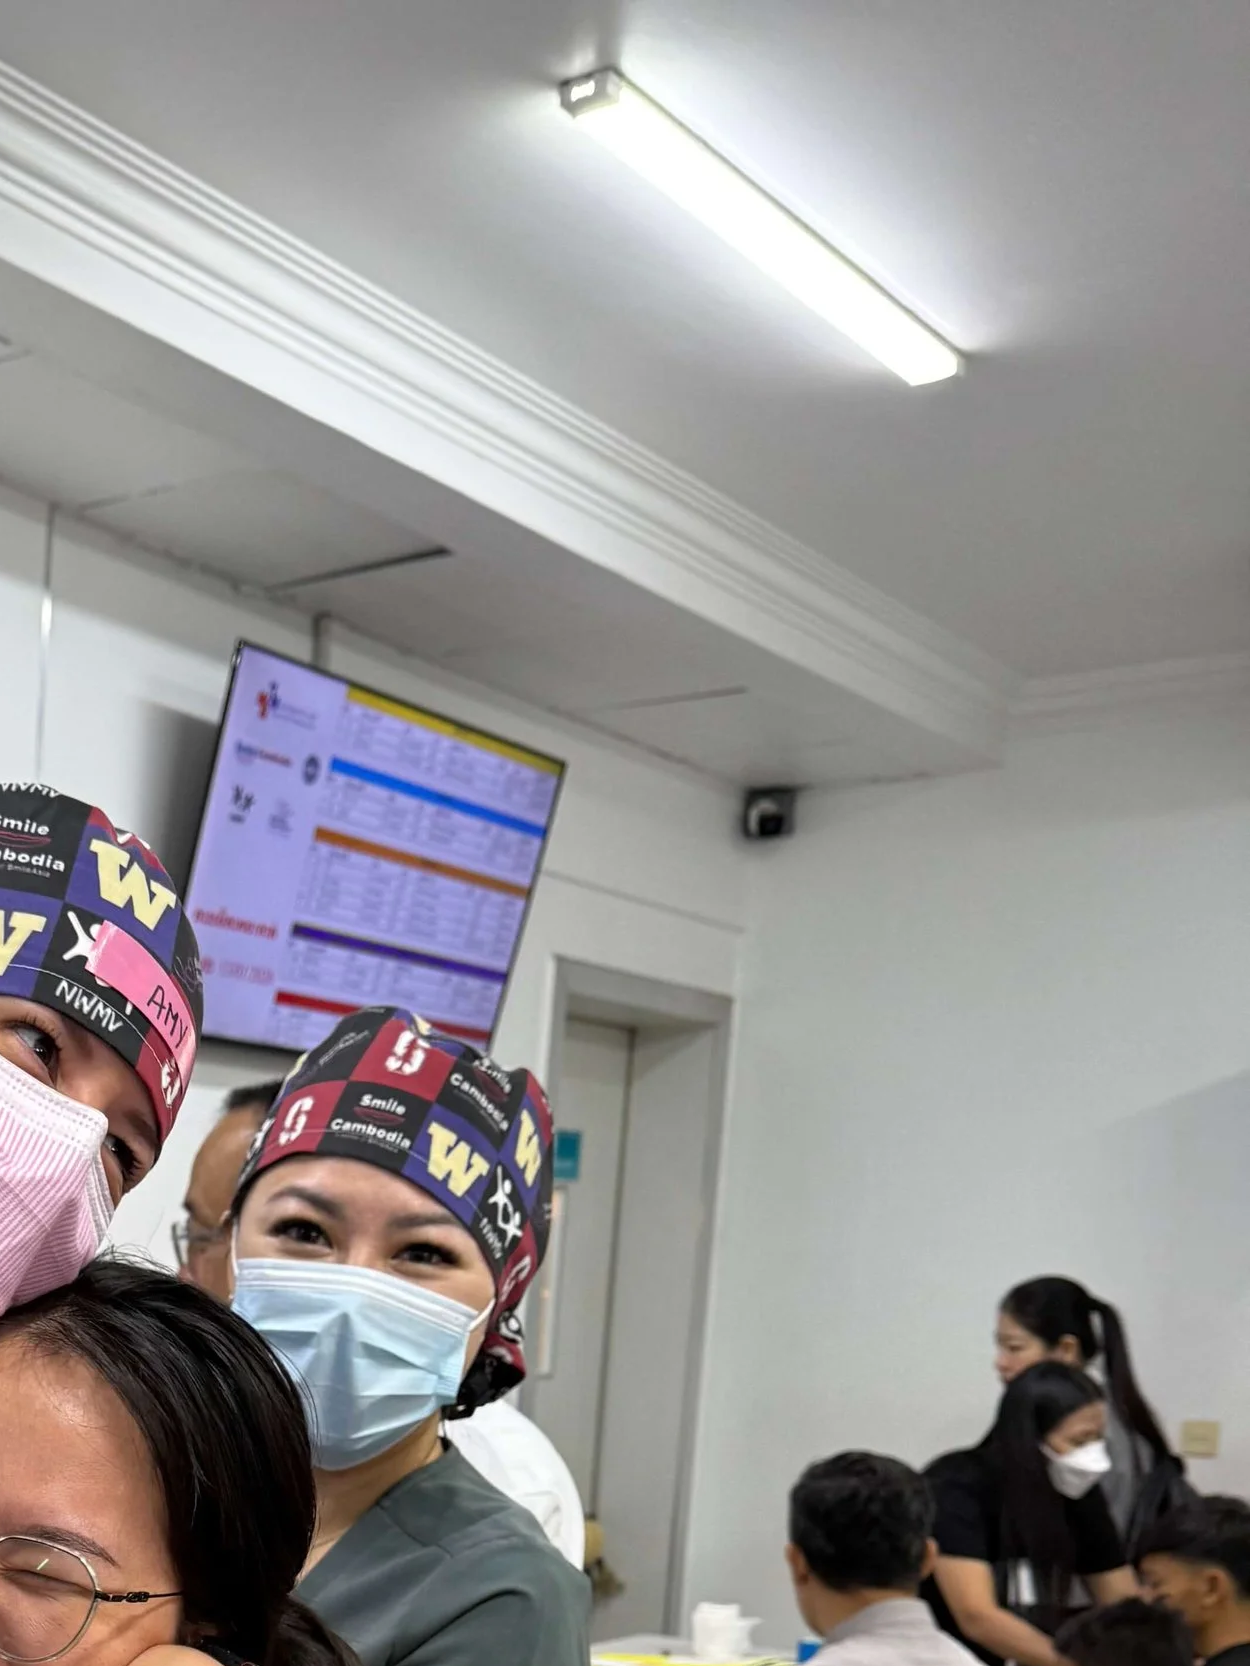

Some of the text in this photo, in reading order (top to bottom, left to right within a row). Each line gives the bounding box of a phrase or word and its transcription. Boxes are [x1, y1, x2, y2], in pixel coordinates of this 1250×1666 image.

[90, 838, 176, 931] W
[55, 980, 124, 1032] NWMV
[147, 985, 188, 1048] AMY
[359, 1093, 406, 1115] Smile
[330, 1118, 412, 1149] Cambodia
[427, 1121, 490, 1198] W
